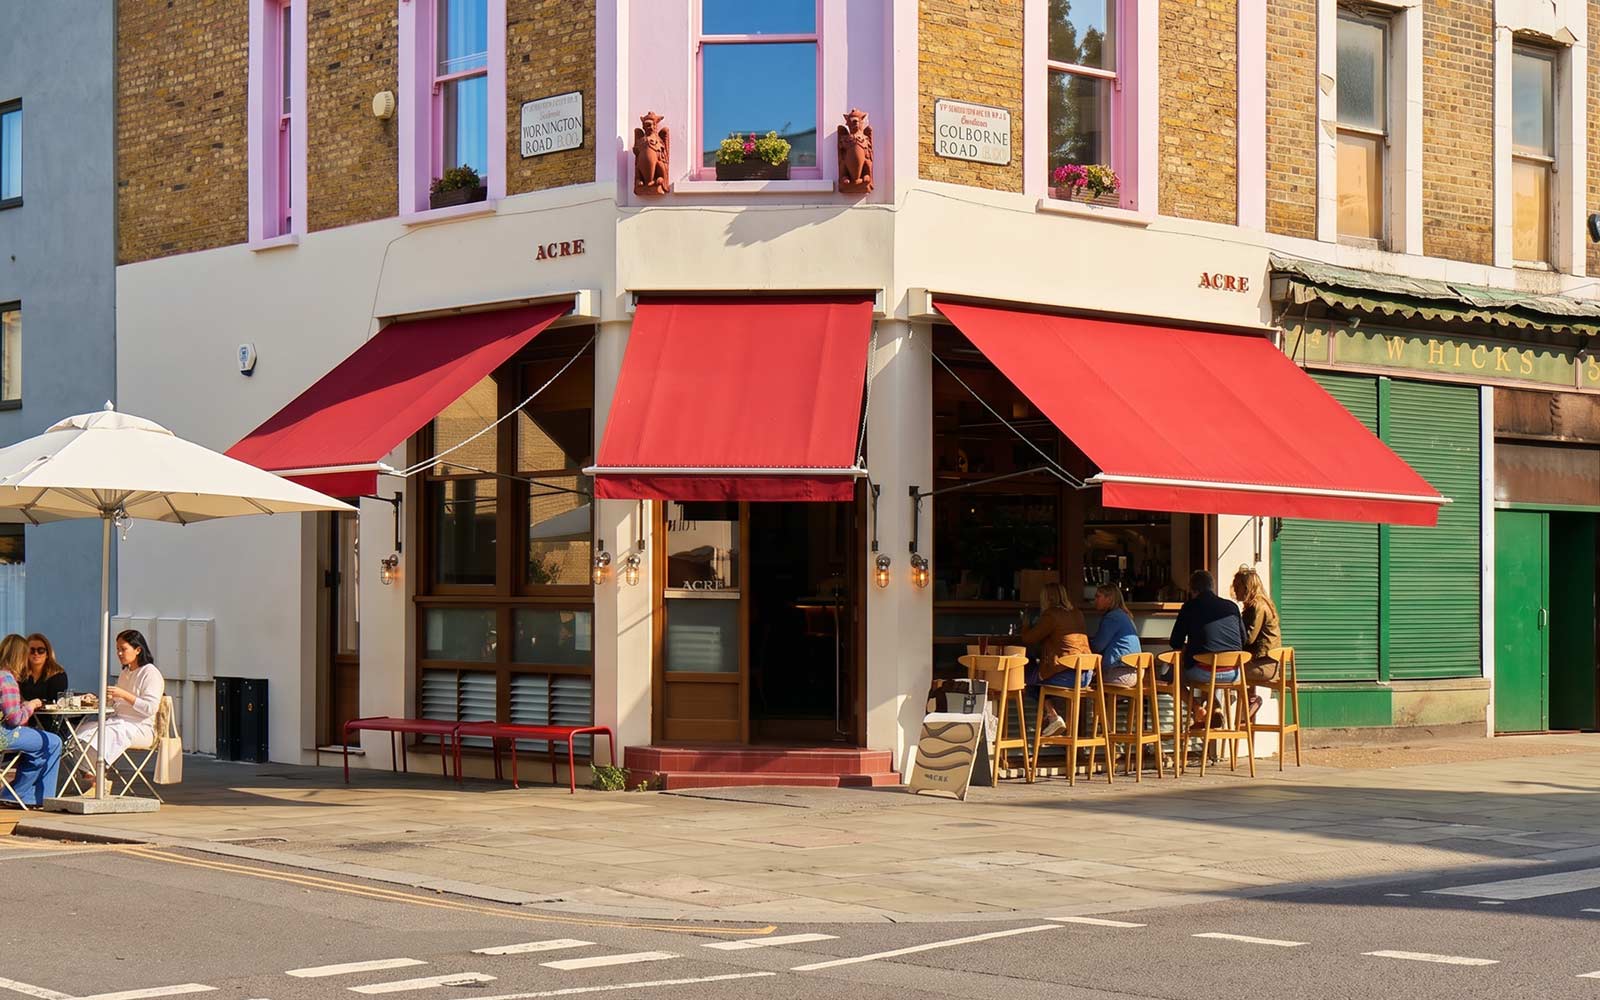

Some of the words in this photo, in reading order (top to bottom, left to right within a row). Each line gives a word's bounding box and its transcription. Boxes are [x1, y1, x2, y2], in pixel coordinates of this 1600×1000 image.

[523, 117, 582, 139] WORNINGTON
[939, 124, 1009, 146] COLBORNE
[525, 137, 553, 155] ROAD
[940, 140, 978, 157] ROAD
[535, 239, 585, 260] ACRE
[1198, 272, 1249, 292] ACRE
[1385, 336, 1407, 360] W
[1428, 339, 1534, 374] HICKS
[682, 580, 724, 591] ACRE
